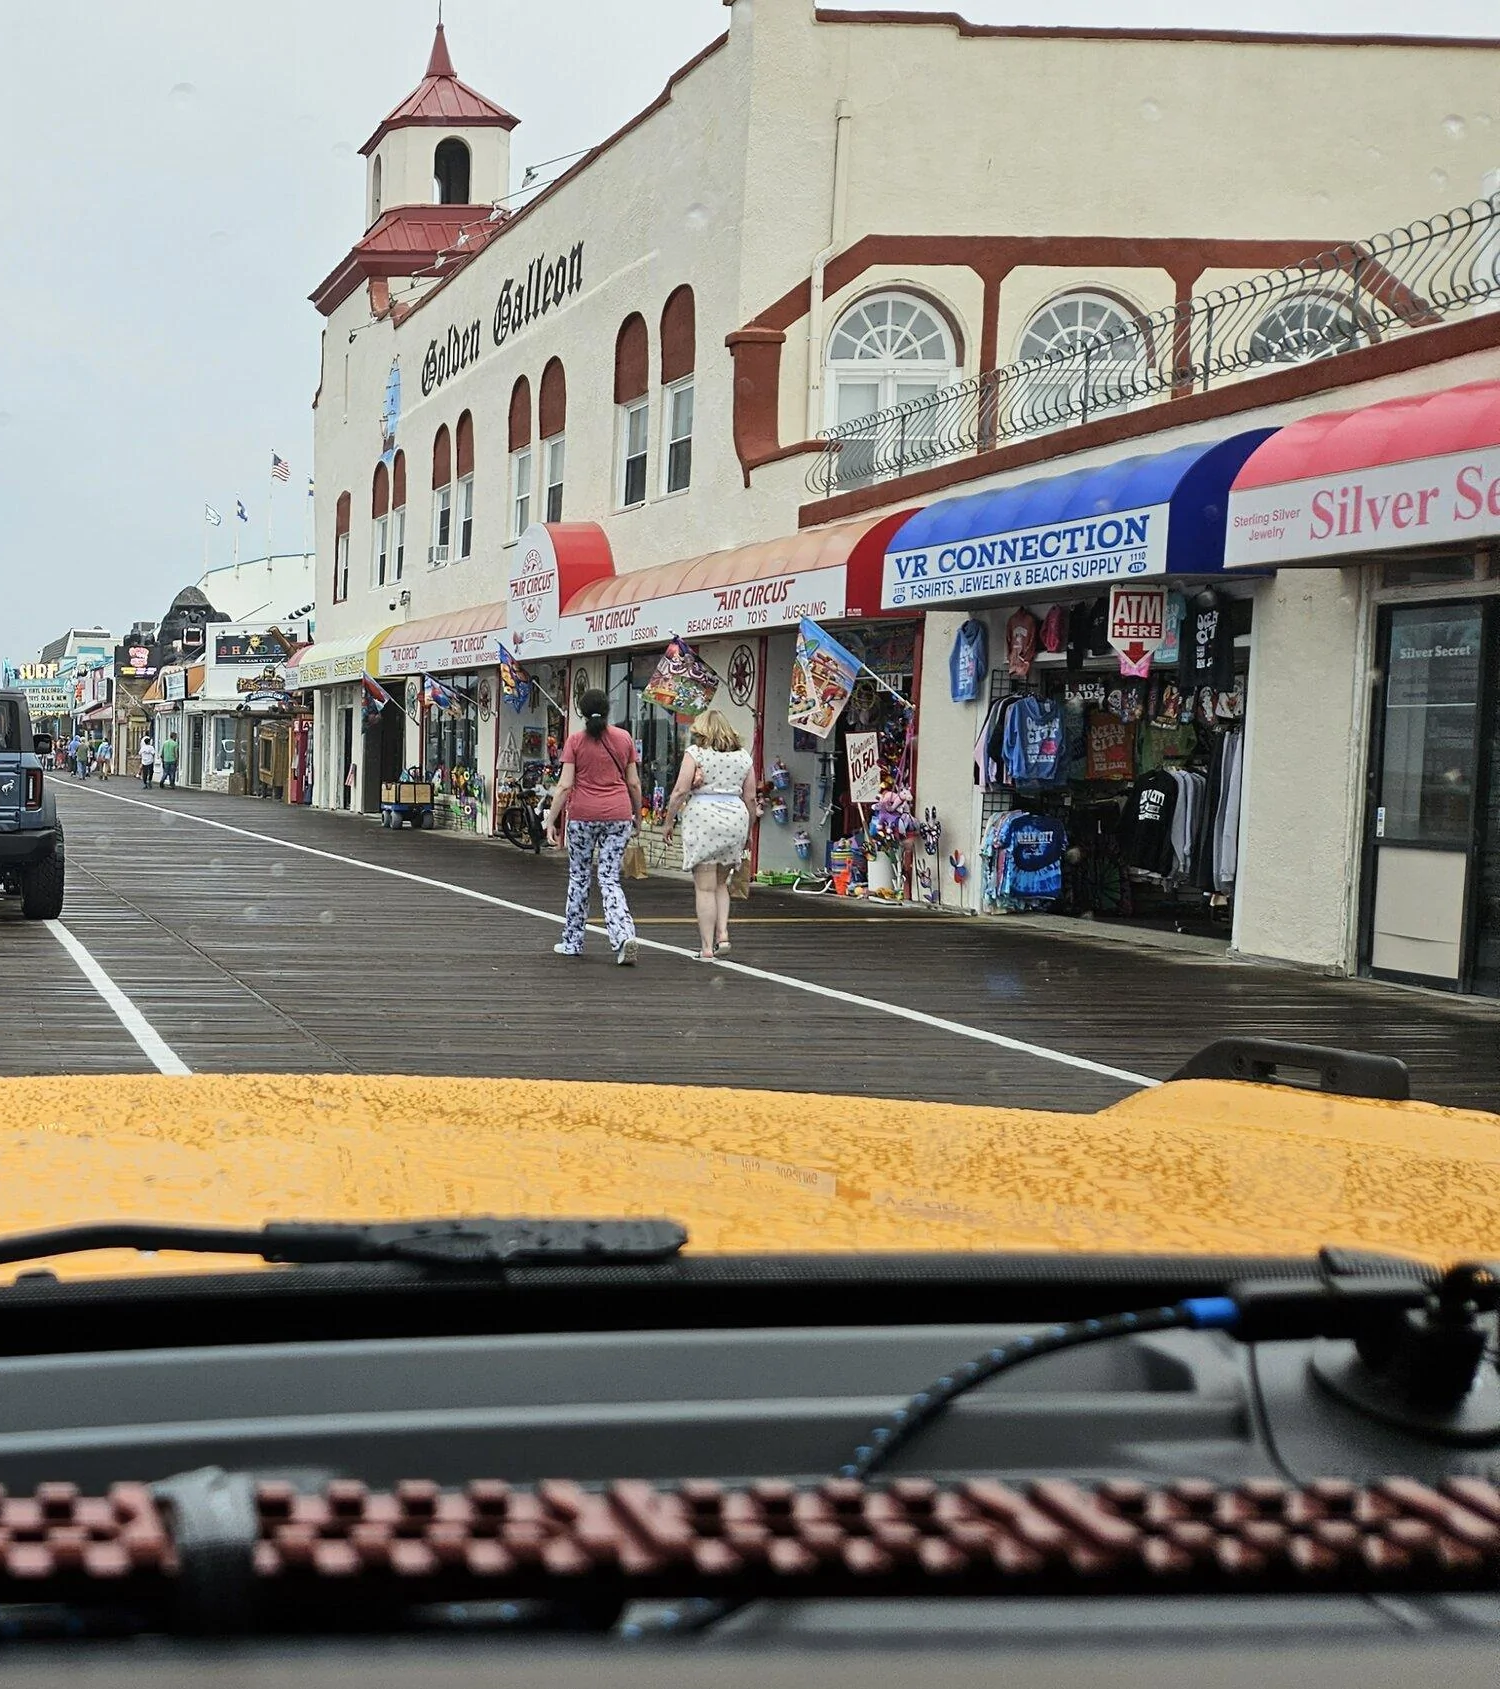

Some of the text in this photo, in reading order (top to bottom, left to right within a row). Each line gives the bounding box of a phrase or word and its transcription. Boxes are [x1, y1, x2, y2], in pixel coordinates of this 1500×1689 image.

[421, 240, 584, 397] Golden Galleon
[1234, 507, 1301, 529] Sterling Silver
[1310, 485, 1440, 540] Silver
[1248, 526, 1285, 541] Jewelry
[895, 514, 1150, 580] VR CONNECTION
[1130, 552, 1145, 561] 1110
[910, 555, 1122, 599] T-SHIRTS, JEWELRY & BEACH SUPPLY
[1131, 563, 1144, 572] ATM
[510, 573, 554, 598] AIR CIRCUS
[714, 579, 795, 611] AIR CIRCUS
[586, 607, 640, 633] AIR CIRCUS
[687, 618, 711, 633] BEACH
[712, 615, 733, 629] GEAR
[747, 610, 767, 624] TOYS
[782, 601, 826, 619] JUGGLING
[1113, 595, 1161, 624] ATM
[570, 638, 585, 650] KITES
[630, 626, 658, 641] LESSONS
[1113, 625, 1160, 637] HERE
[220, 644, 281, 655] SHADE
[401, 646, 419, 660] CIRCUS
[451, 635, 487, 653] AIR CIRCUS
[1400, 645, 1471, 659] Silver Secret
[19, 663, 59, 679] SURF
[1092, 735, 1125, 751] CITY
